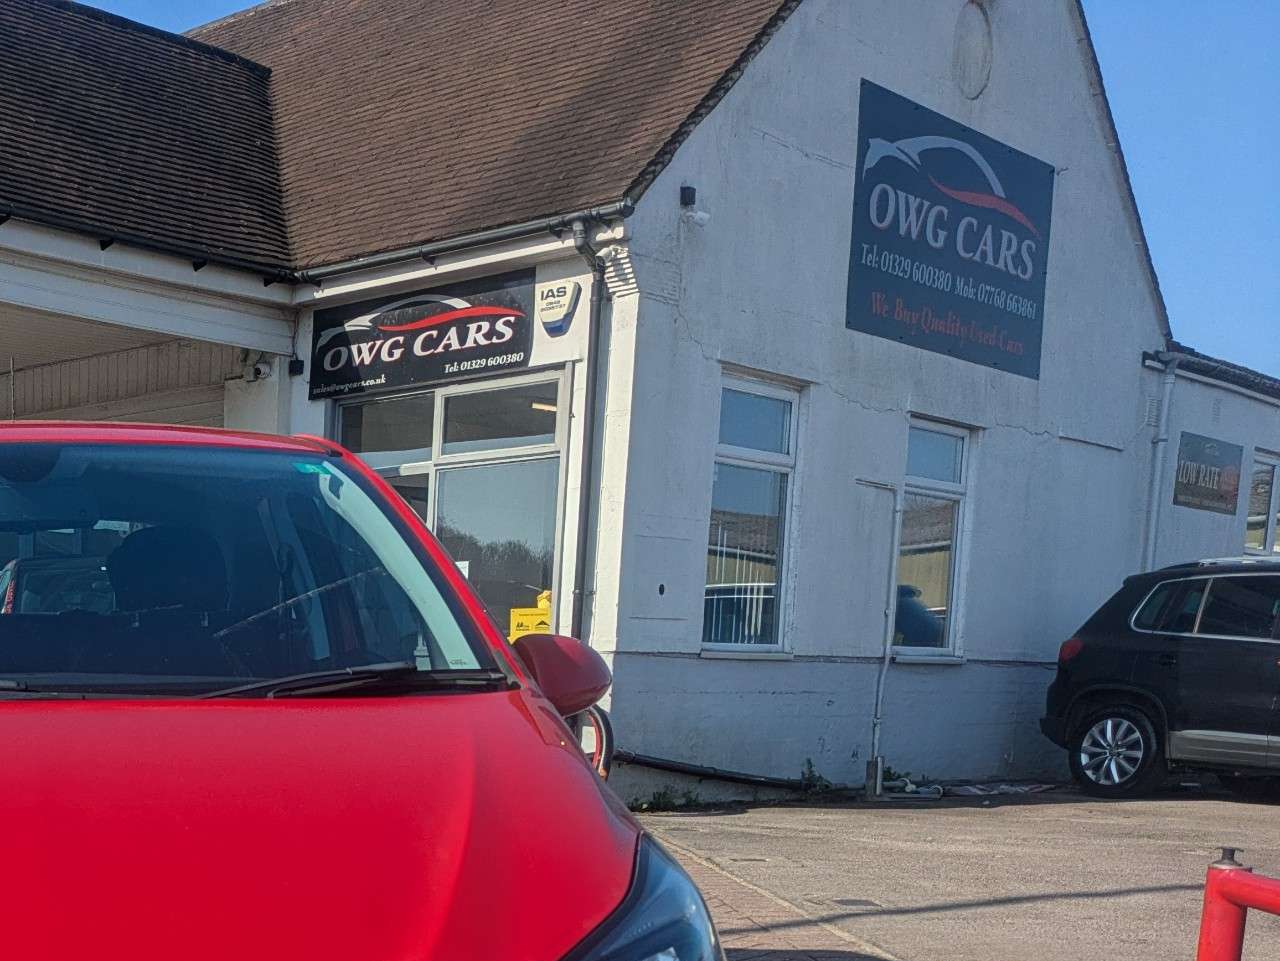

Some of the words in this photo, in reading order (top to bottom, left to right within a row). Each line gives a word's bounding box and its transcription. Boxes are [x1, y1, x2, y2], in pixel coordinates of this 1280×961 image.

[870, 183, 949, 249] OWG
[956, 216, 1036, 280] CARS
[540, 286, 567, 301] IAS
[862, 243, 879, 269] Tel:
[881, 251, 911, 279] 01329
[912, 262, 952, 292] 600380
[978, 283, 1006, 309] 07768
[323, 336, 405, 371] OWG
[413, 316, 515, 357] CARS
[444, 361, 459, 373] Tel:
[460, 359, 486, 371] 01329
[487, 352, 524, 367] 600380
